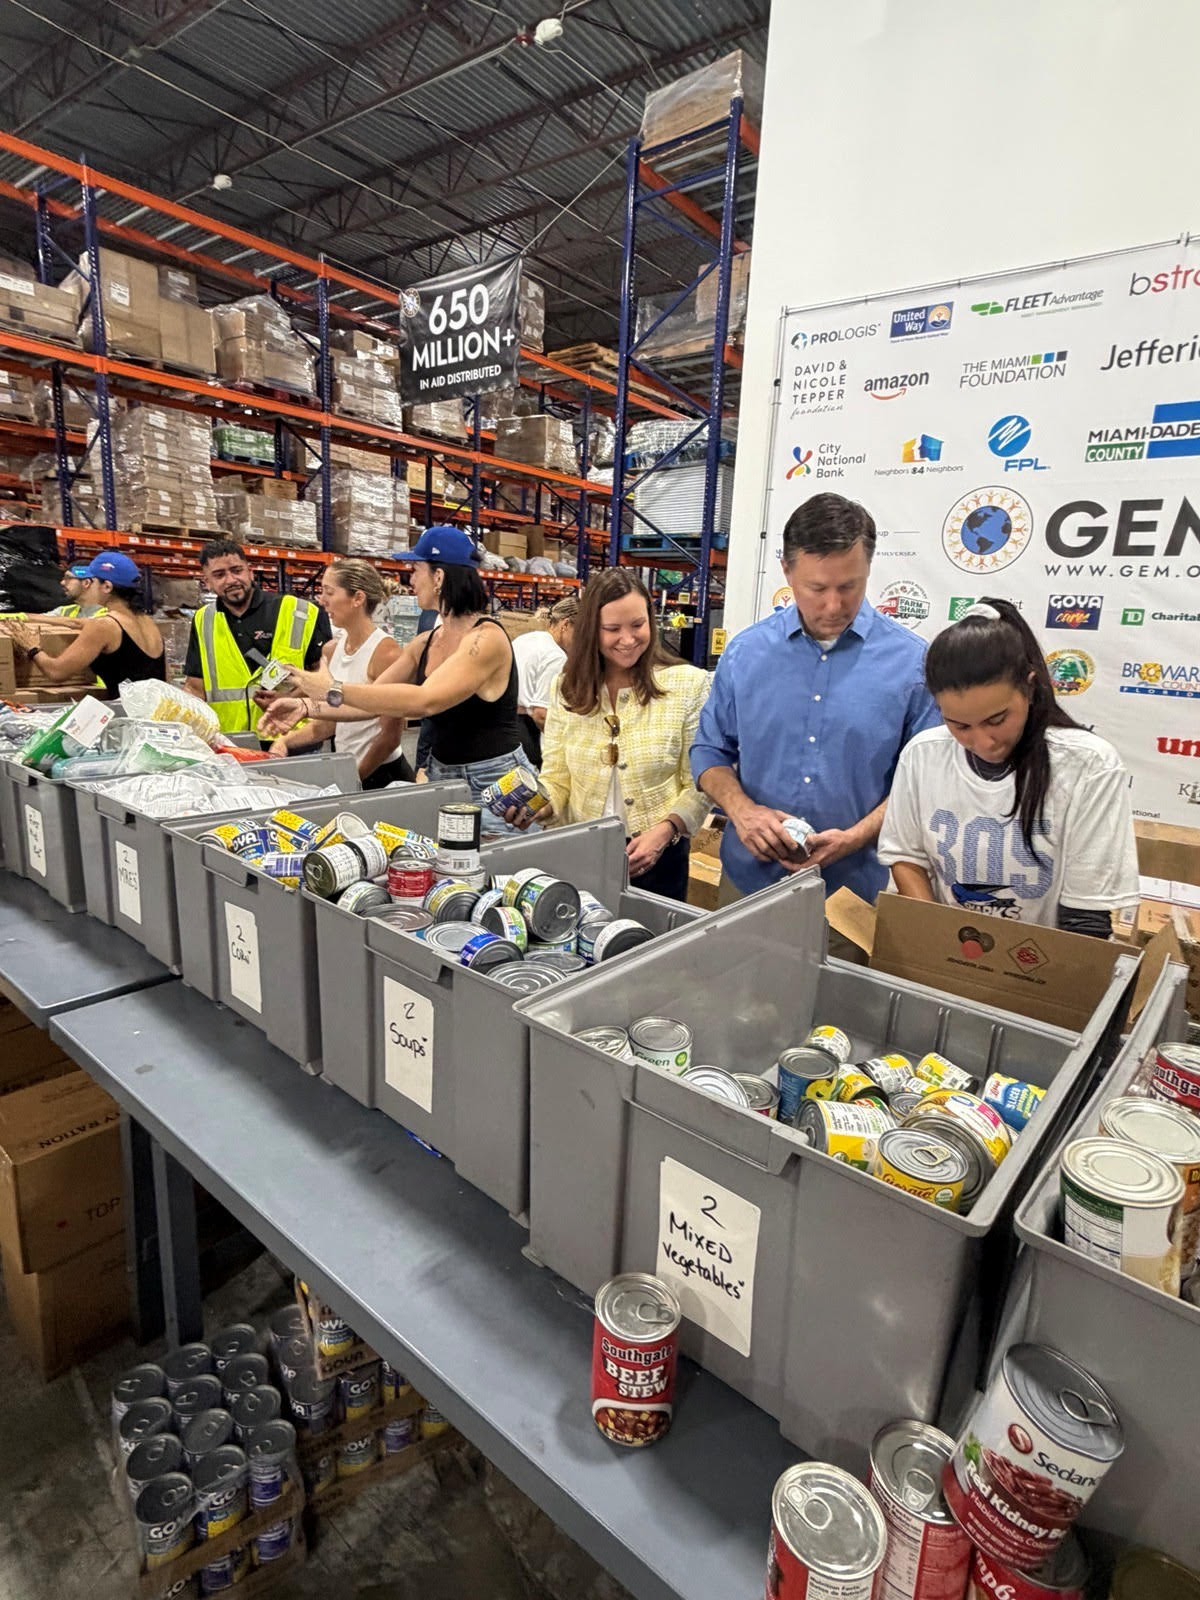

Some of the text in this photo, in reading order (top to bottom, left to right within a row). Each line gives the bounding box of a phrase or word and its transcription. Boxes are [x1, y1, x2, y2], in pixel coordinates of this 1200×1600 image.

[428, 283, 490, 335] 650
[1005, 292, 1052, 312] FLEET
[1050, 289, 1104, 305] Advantage
[893, 310, 926, 323] United
[810, 323, 879, 345] PROLOGIS
[904, 320, 926, 333] Way
[411, 326, 515, 371] MILLION+
[1100, 334, 1200, 371] Jefferi
[794, 359, 848, 377] DAVID &
[963, 355, 1031, 373] THE MIAMI
[419, 364, 502, 390] IN AID DISTRIBUTED
[792, 374, 847, 391] NICOLE
[864, 371, 930, 392] amazon
[960, 363, 1067, 388] FOUNDATION
[792, 388, 846, 405] TEPPER
[790, 404, 844, 420] foundation
[818, 443, 841, 455] City
[1086, 446, 1143, 462] COUNTY
[817, 453, 866, 467] National
[1004, 457, 1046, 472] FPL
[816, 467, 845, 479] Bank
[874, 468, 910, 477] Neighbors
[926, 464, 964, 474] Neighbors
[899, 606, 927, 614] SHARE
[900, 599, 923, 608] FARM
[1050, 595, 1102, 609] GOYA
[1125, 611, 1143, 623] TD
[929, 808, 1054, 899] 305
[235, 924, 246, 943] 2
[403, 1002, 416, 1020] 2
[39, 1121, 100, 1149] RATION
[85, 1197, 121, 1223] TOP
[701, 1195, 727, 1230] 2
[605, 1358, 665, 1386] BEEF
[618, 1376, 669, 1399] STEW
[966, 1460, 992, 1494] Red
[990, 1495, 1049, 1539] Kidney
